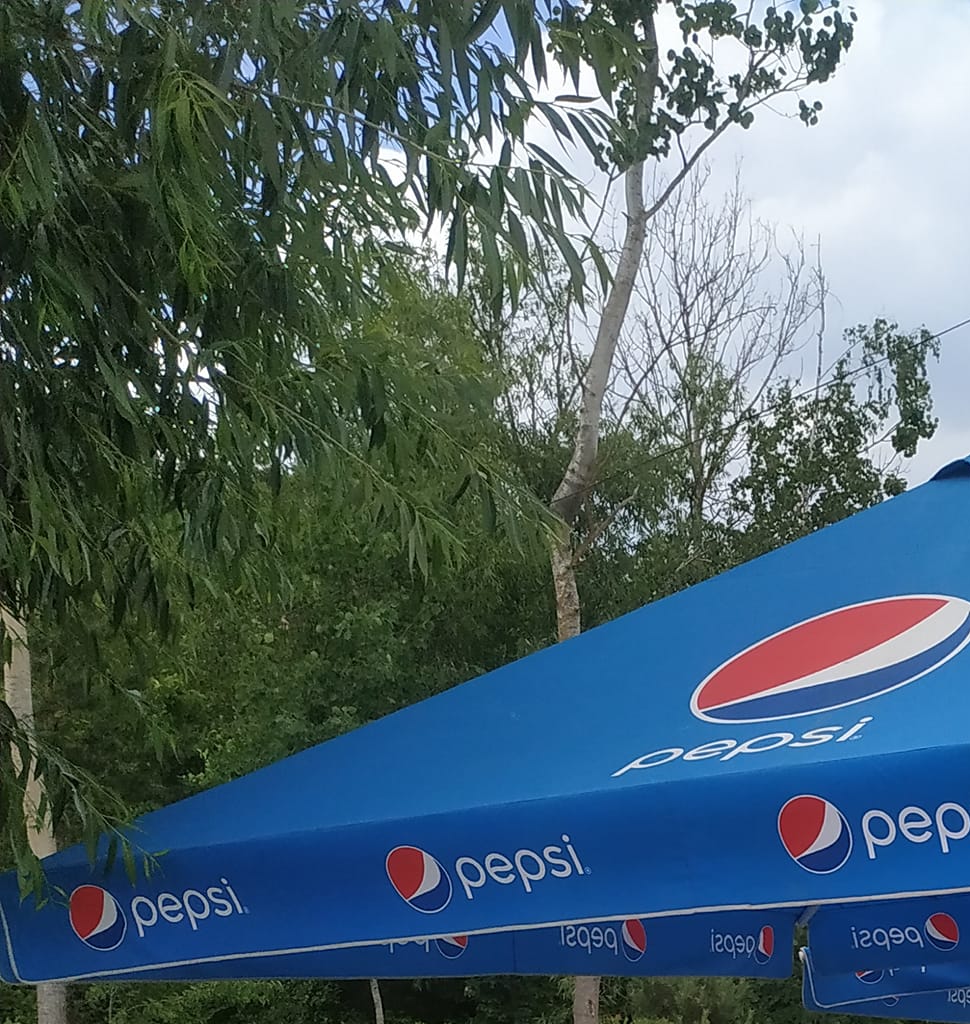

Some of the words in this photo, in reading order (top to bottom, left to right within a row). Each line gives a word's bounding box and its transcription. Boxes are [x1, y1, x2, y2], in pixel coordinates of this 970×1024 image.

[610, 716, 874, 777] pepsi
[455, 834, 586, 900] pepsi
[130, 877, 245, 937] pepsi
